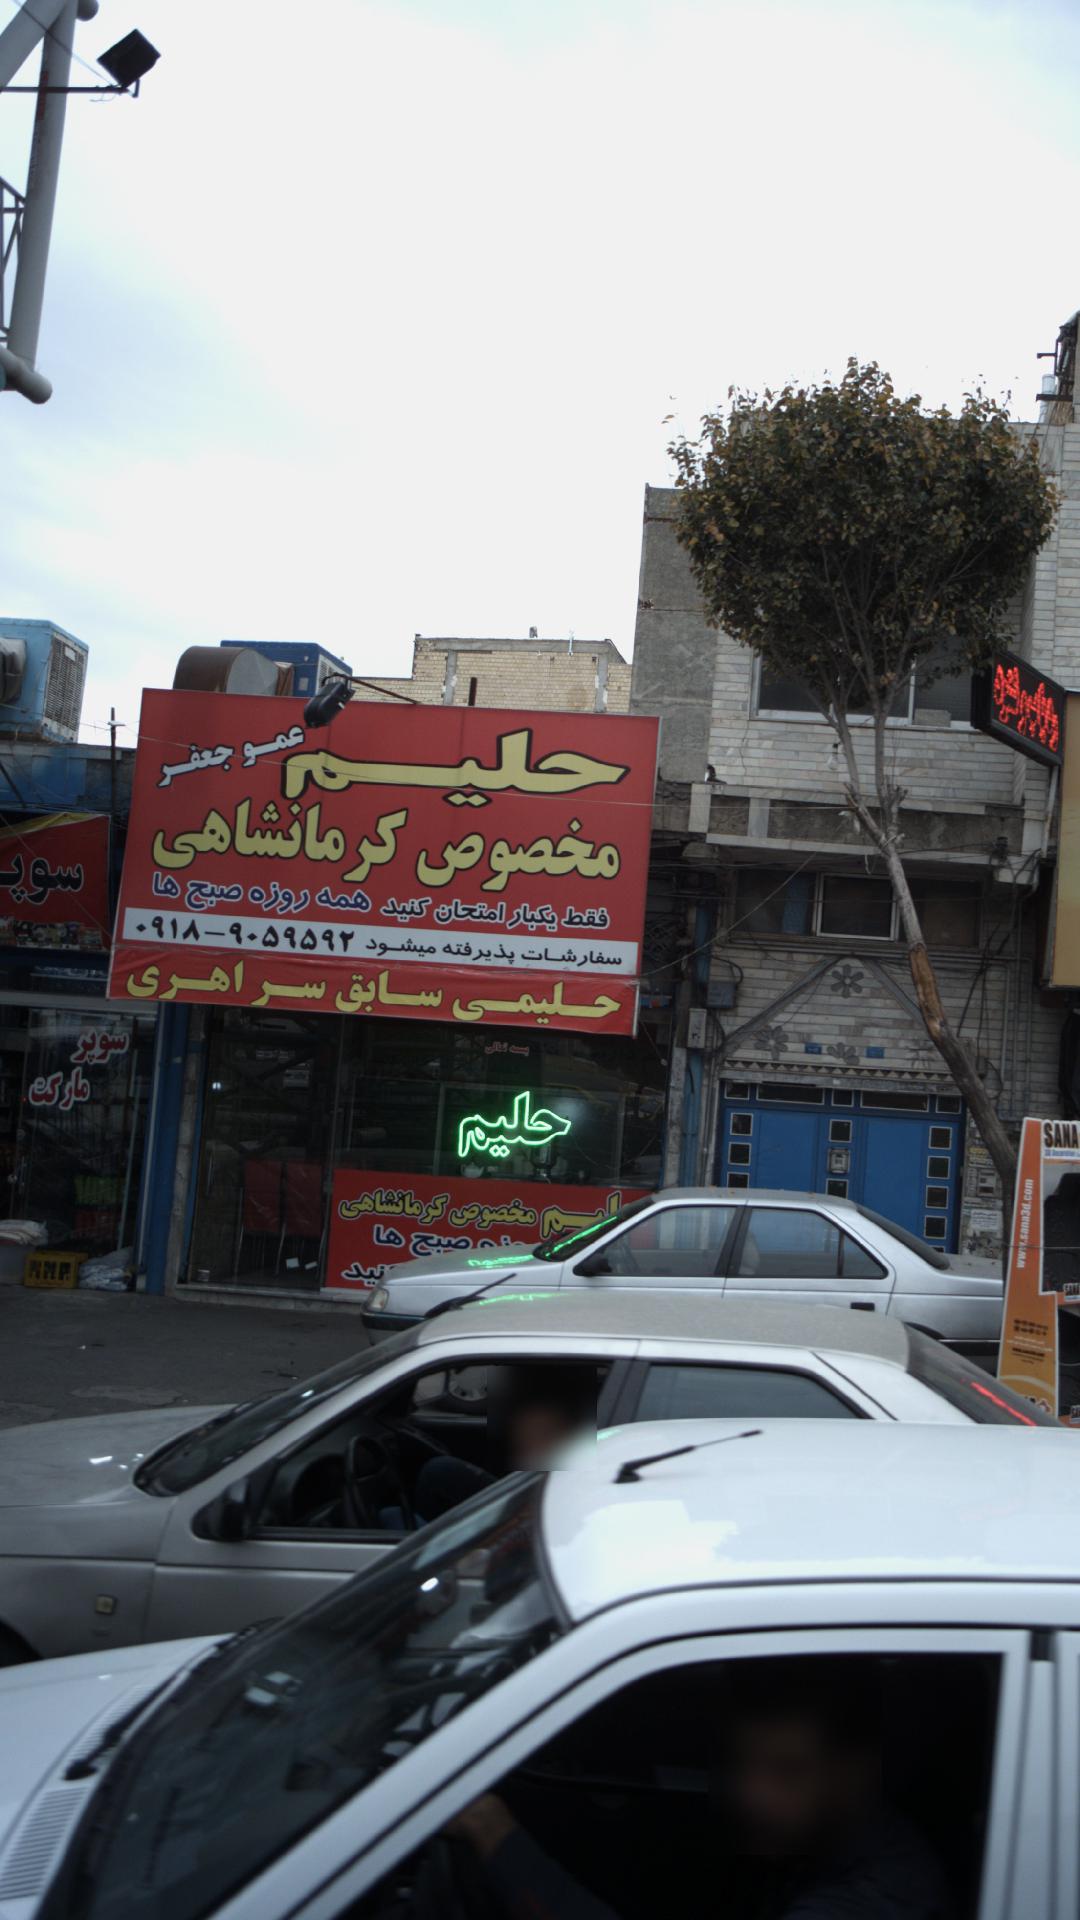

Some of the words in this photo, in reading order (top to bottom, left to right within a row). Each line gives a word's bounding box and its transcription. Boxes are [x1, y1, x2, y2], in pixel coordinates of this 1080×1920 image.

[242, 725, 304, 766] عمو
[156, 743, 234, 787] جعفر
[280, 728, 629, 806] حلیم
[151, 797, 408, 882] کرمانشاهی
[415, 818, 621, 891] مخصوص
[0, 855, 83, 903] سوپ
[152, 872, 181, 897] ها
[184, 879, 244, 909] صبح
[249, 882, 311, 914] روزه
[315, 887, 372, 912] همه
[382, 898, 432, 922] کنید
[433, 899, 505, 926] امتحان
[506, 904, 557, 931] یکبار
[561, 907, 611, 930] فقط
[365, 936, 437, 956] میشود
[441, 941, 515, 964] پذیرفته
[520, 949, 622, 966] سفارشات
[250, 976, 327, 1007] سر
[335, 968, 443, 1013] سابق
[451, 981, 622, 1024] حلیمی
[70, 1026, 129, 1063] سوپر
[28, 1066, 90, 1109] مارکت
[458, 1091, 572, 1158] حلیم
[339, 1188, 449, 1224] کرمانشاهی
[450, 1199, 537, 1229] مخصوص
[373, 1225, 404, 1247] ها
[411, 1232, 472, 1256] صبح
